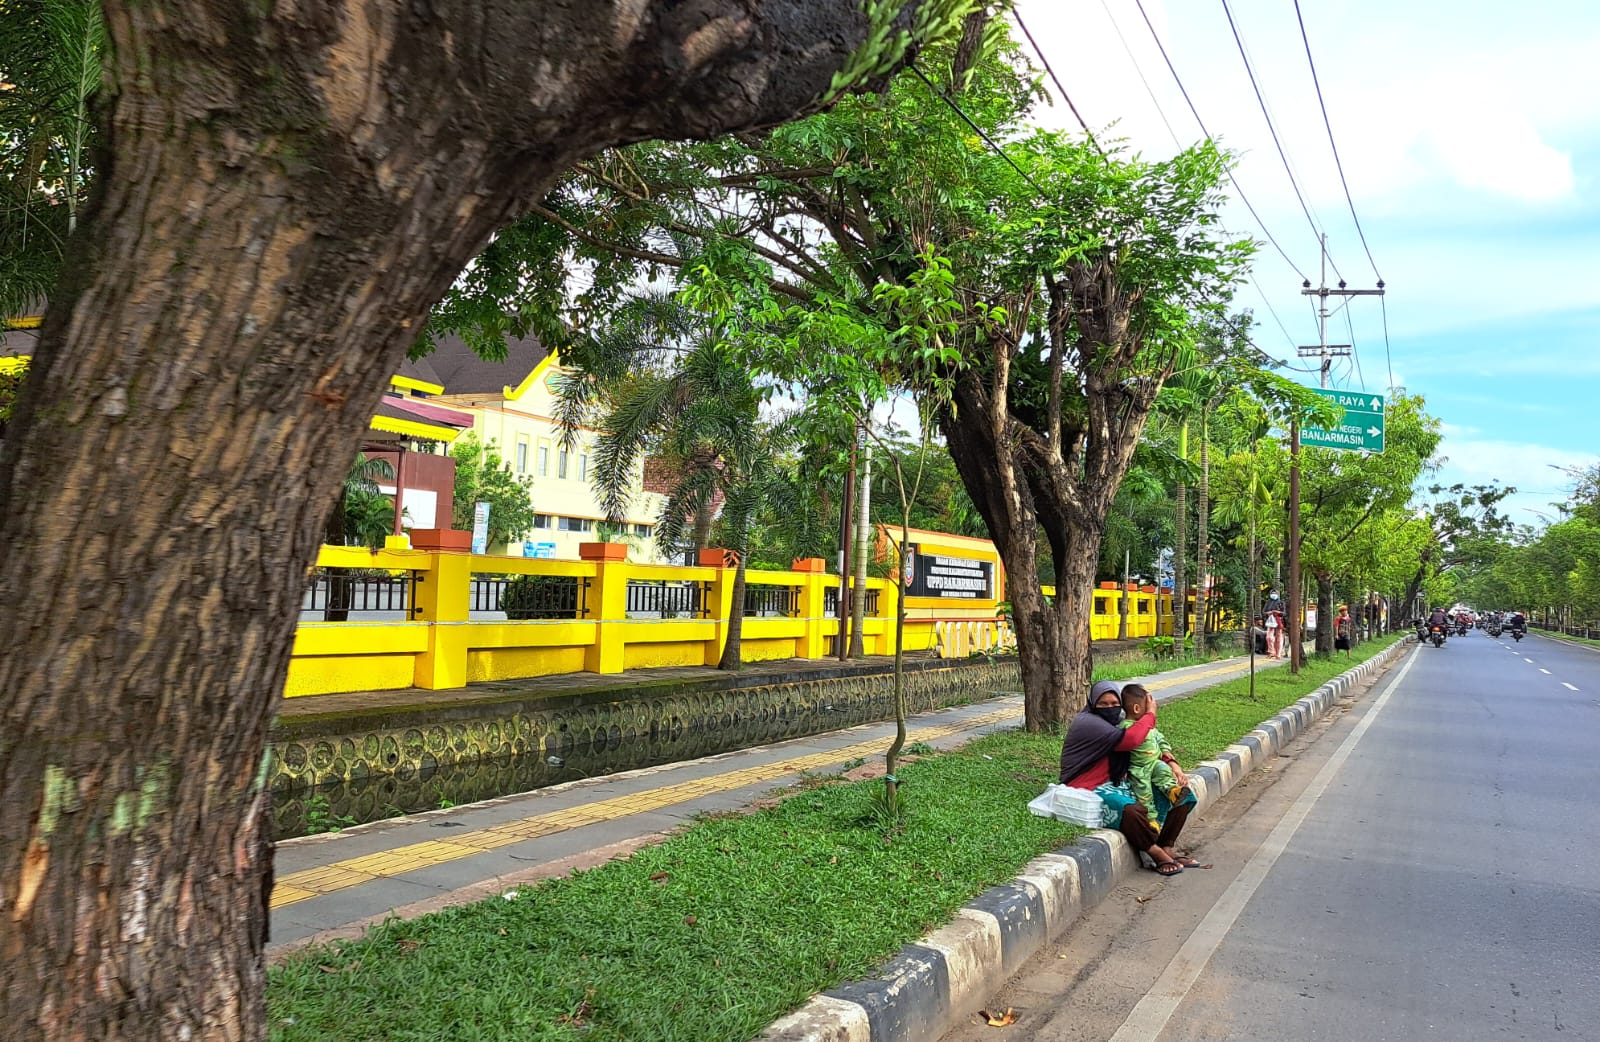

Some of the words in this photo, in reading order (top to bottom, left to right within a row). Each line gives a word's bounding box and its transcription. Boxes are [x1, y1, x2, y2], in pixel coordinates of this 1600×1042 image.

[1339, 396, 1365, 407] RAYA
[1339, 425, 1362, 434] NEGERI
[1302, 430, 1364, 445] BANJARMASIN
